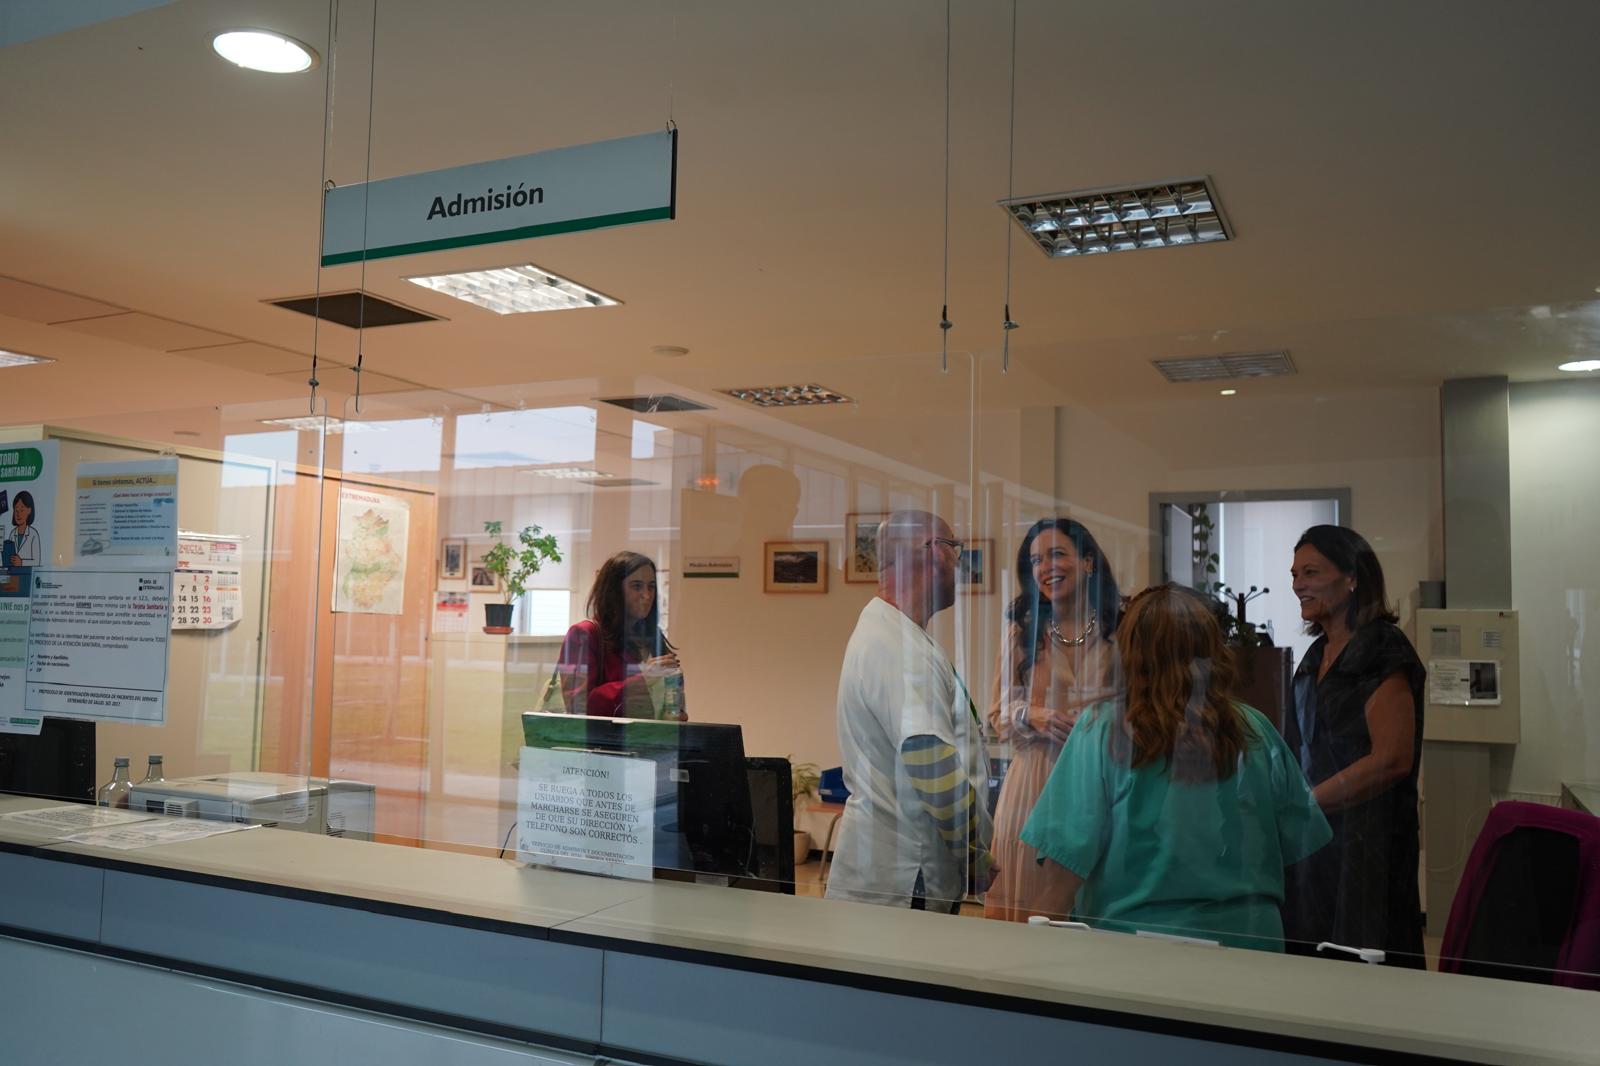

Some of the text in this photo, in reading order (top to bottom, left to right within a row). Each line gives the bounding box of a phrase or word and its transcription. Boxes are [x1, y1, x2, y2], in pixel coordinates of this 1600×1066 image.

[427, 182, 544, 221] Admisión
[562, 766, 610, 779] ¡ATENCIÓN!
[534, 792, 636, 813] USUARIOS QUE ANTES DE
[538, 783, 633, 802] SE RUEGA A TODOS LOS
[530, 802, 639, 823] MARCHARSE SE ASEGUREN
[536, 812, 633, 832] DE QUE SU DIRECCIÓN Y
[569, 826, 586, 837] SON
